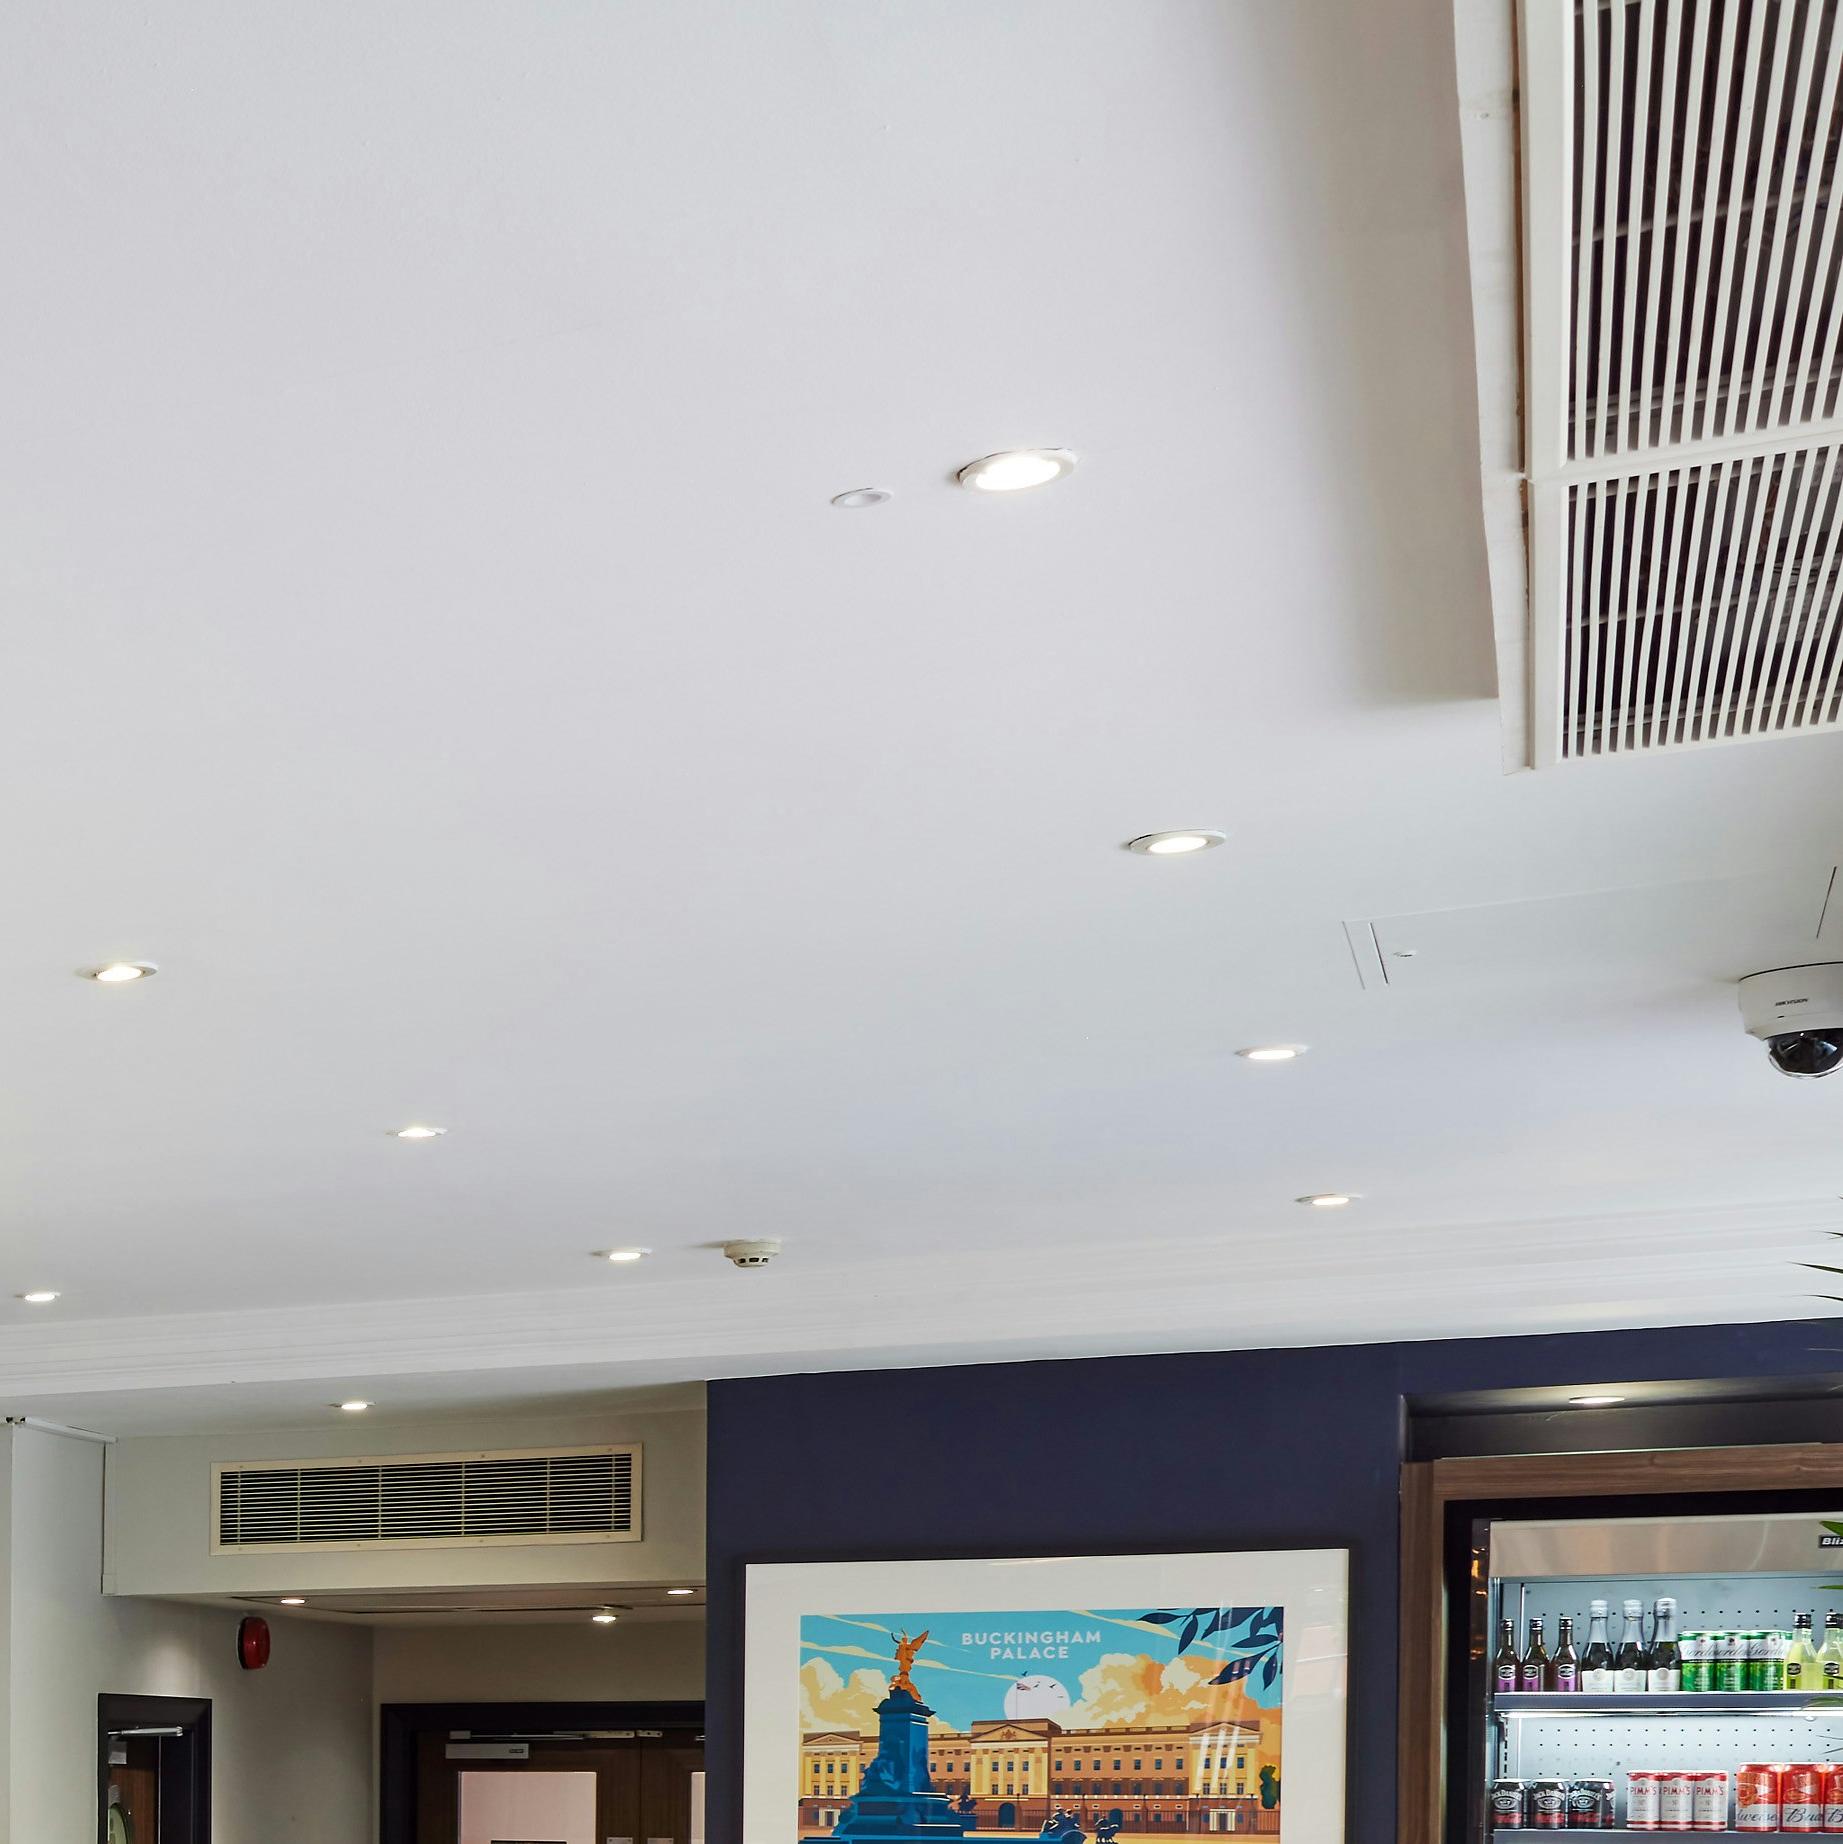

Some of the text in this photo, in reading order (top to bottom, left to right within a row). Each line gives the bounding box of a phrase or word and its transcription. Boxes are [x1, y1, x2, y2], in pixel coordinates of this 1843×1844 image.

[962, 1631, 1101, 1645] BUCKINGHAM
[990, 1646, 1069, 1659] PALACE
[1630, 1786, 1657, 1796] PIMM'S
[1663, 1786, 1691, 1796] PIMM'S
[1696, 1786, 1724, 1796] PIMM'S
